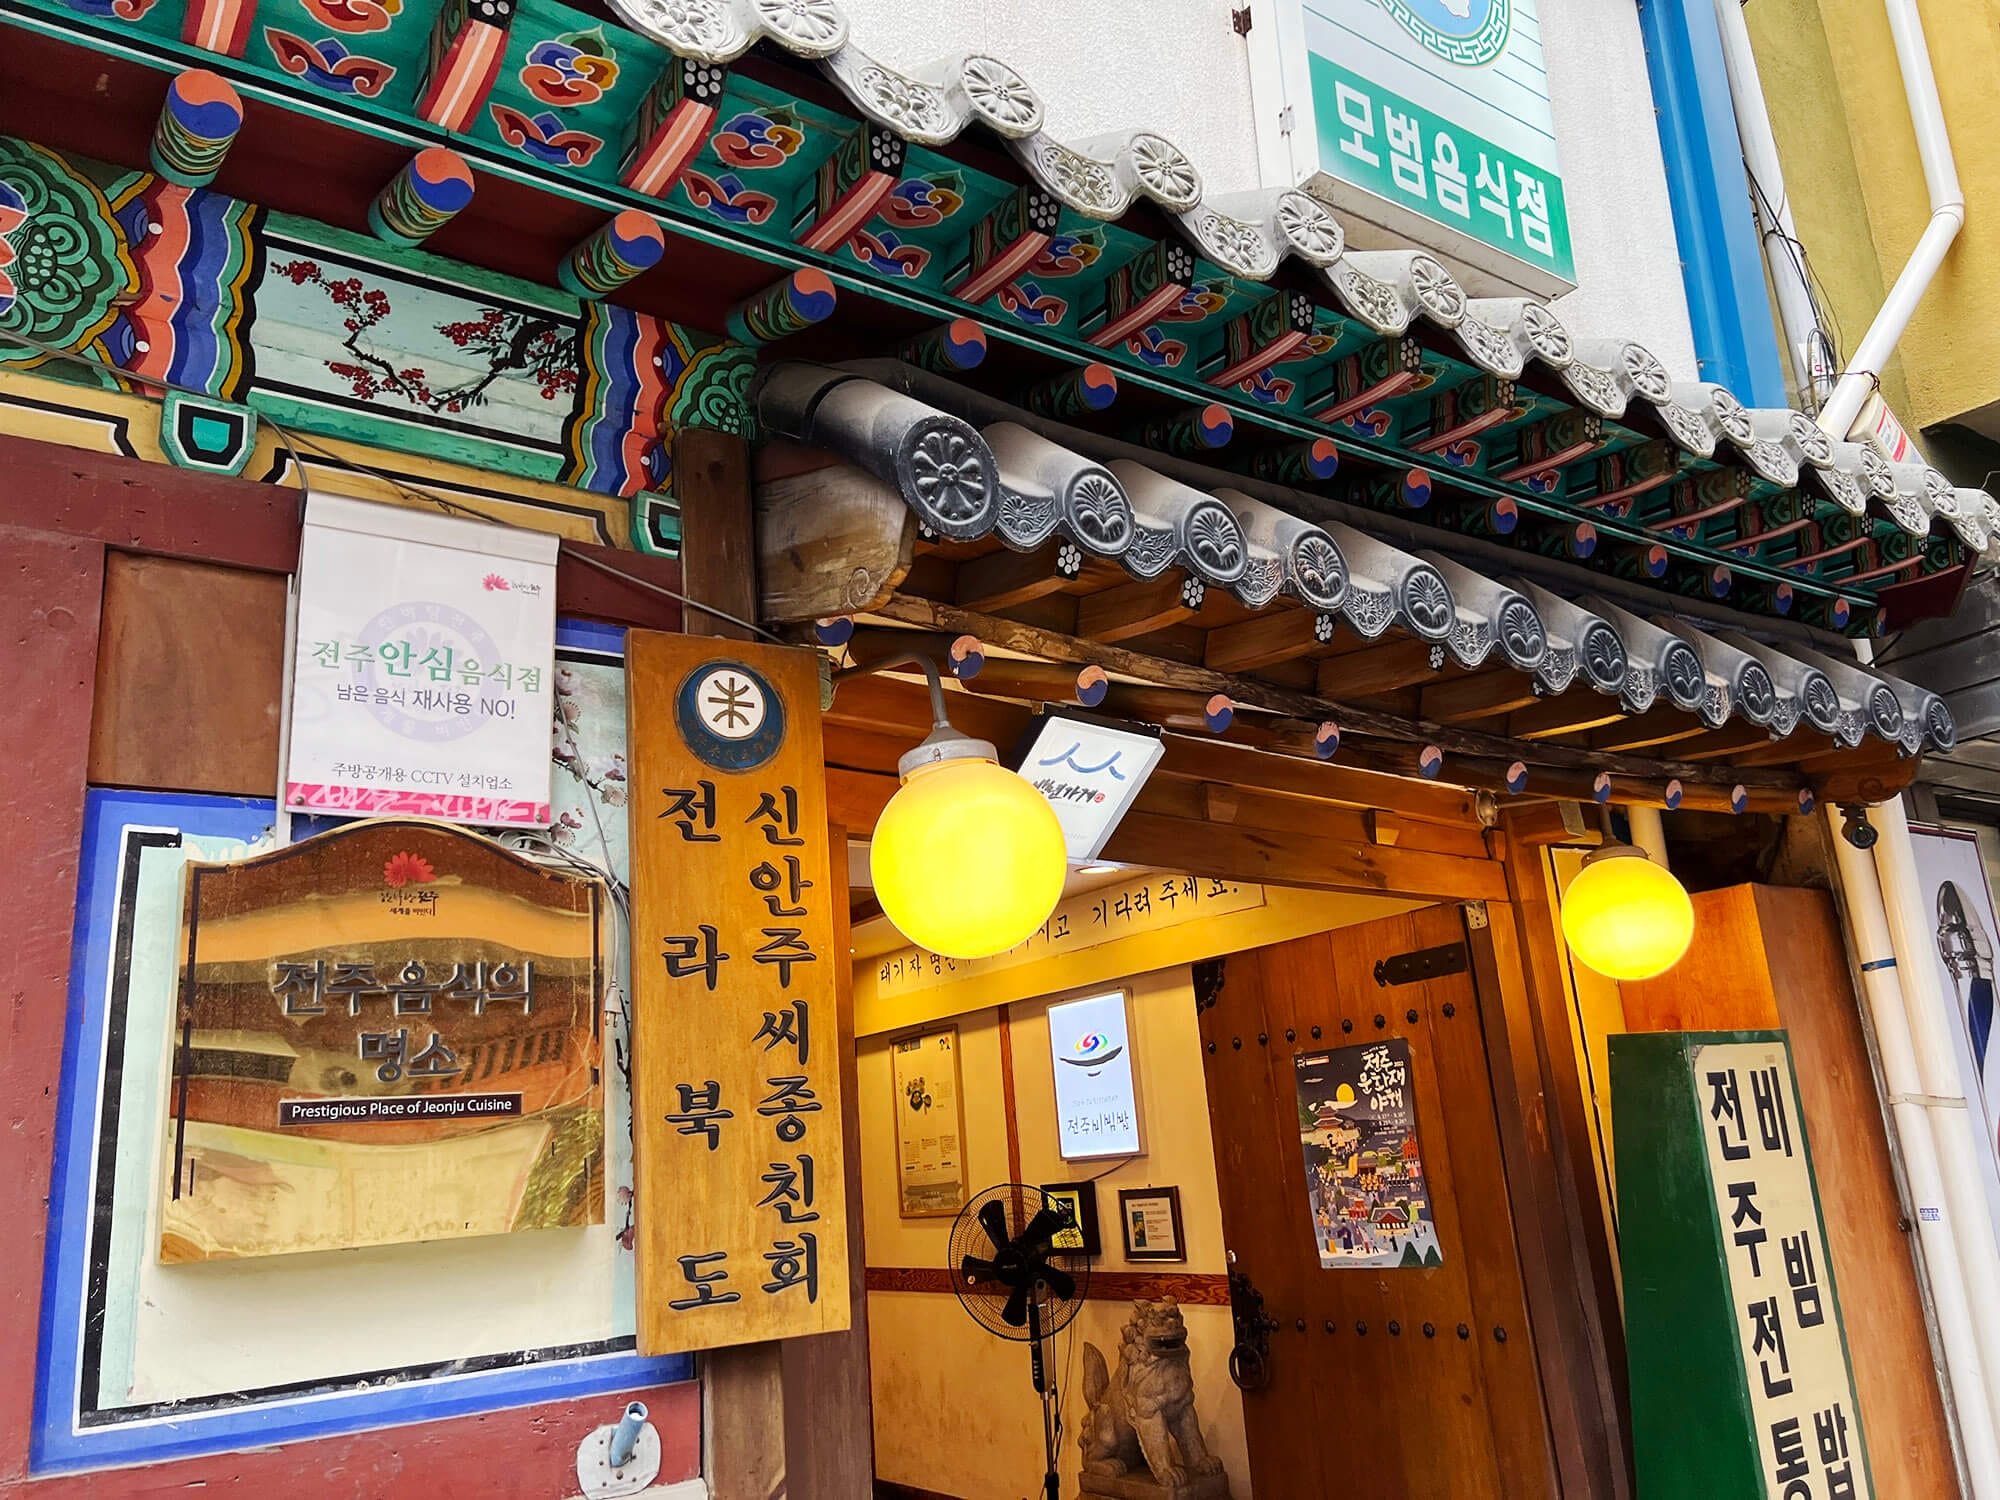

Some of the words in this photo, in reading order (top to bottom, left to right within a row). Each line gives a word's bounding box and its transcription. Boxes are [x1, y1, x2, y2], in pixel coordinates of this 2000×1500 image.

[1335, 80, 1554, 258] 모범음식점
[337, 684, 369, 703] 남은
[373, 687, 406, 707] 음식
[412, 689, 472, 715] 재사용
[480, 699, 515, 719] NO!
[331, 762, 407, 784] 주방공개용
[411, 770, 454, 785] CCTV
[457, 773, 513, 790] 설치업소
[880, 953, 922, 985] 대기자
[1092, 886, 1151, 928] 기다려
[359, 1029, 463, 1083] 명소
[657, 779, 741, 1311] 전라북도
[1362, 1049, 1393, 1072] 전주
[292, 1103, 367, 1120] Prestigious
[369, 1101, 404, 1115] Place
[407, 1100, 421, 1114] of
[423, 1100, 465, 1115] Jeonju
[467, 1099, 512, 1112] Cuisine
[1067, 1110, 1129, 1134] 전주비빔밥
[1750, 1066, 1855, 1500] 비빔밥
